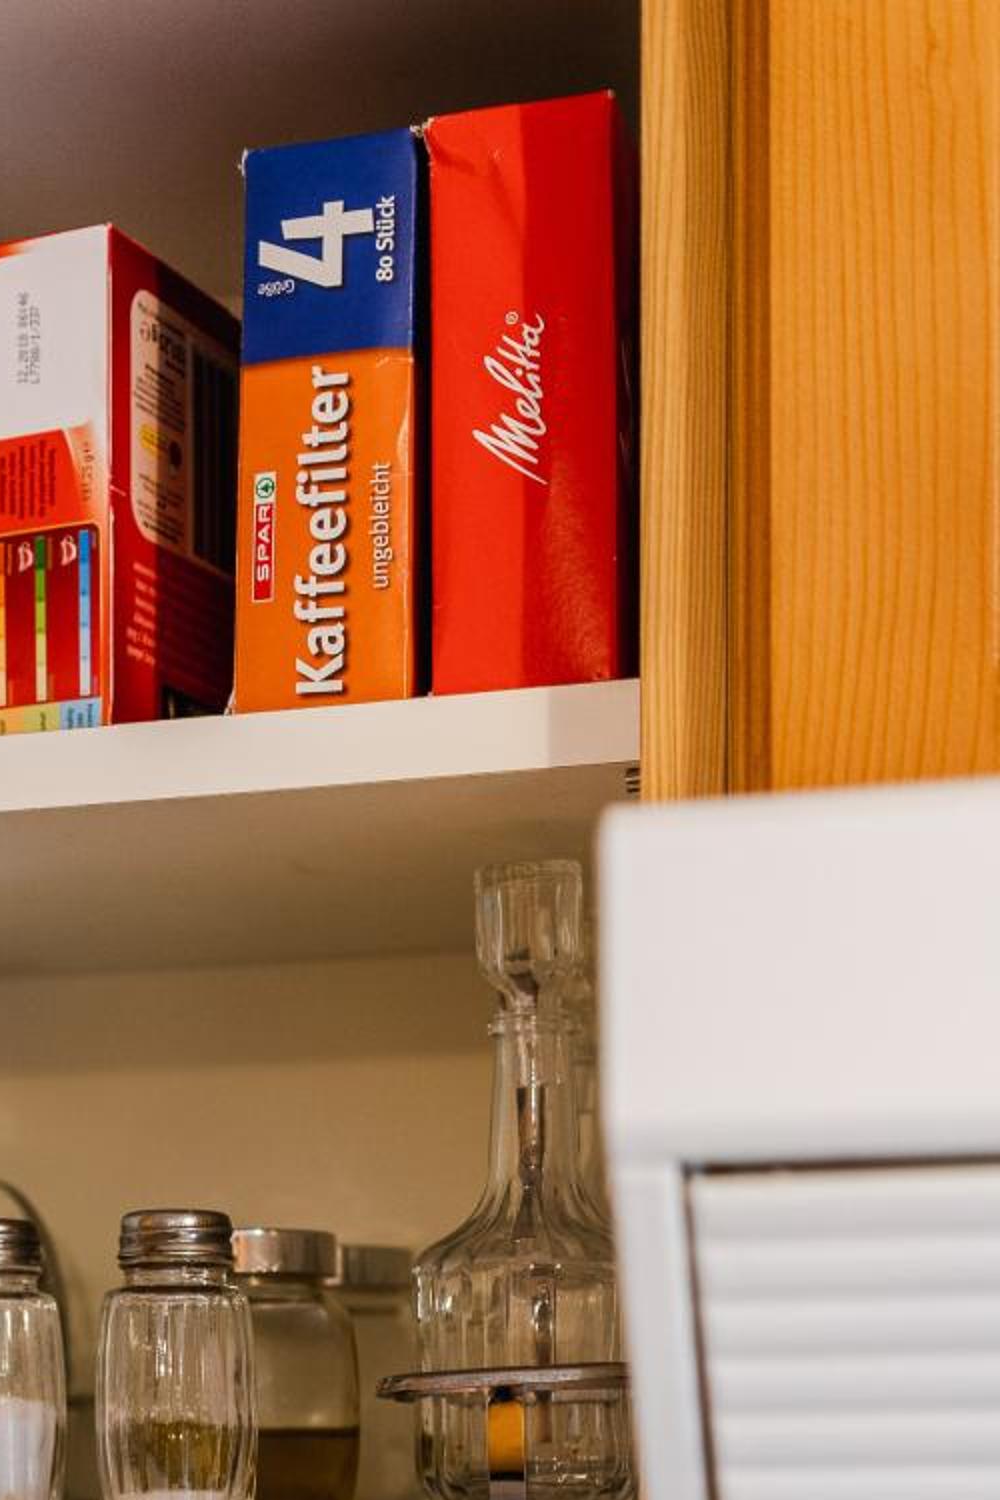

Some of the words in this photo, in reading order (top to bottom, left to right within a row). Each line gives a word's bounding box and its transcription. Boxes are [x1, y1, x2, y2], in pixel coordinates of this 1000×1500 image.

[258, 200, 375, 288] 4
[375, 195, 395, 250] Stück
[375, 254, 394, 282] 80
[472, 313, 548, 485] Melitta
[256, 504, 273, 581] SPAR
[294, 366, 350, 695] Kaffeefilter
[371, 461, 392, 590] ungebleicht
